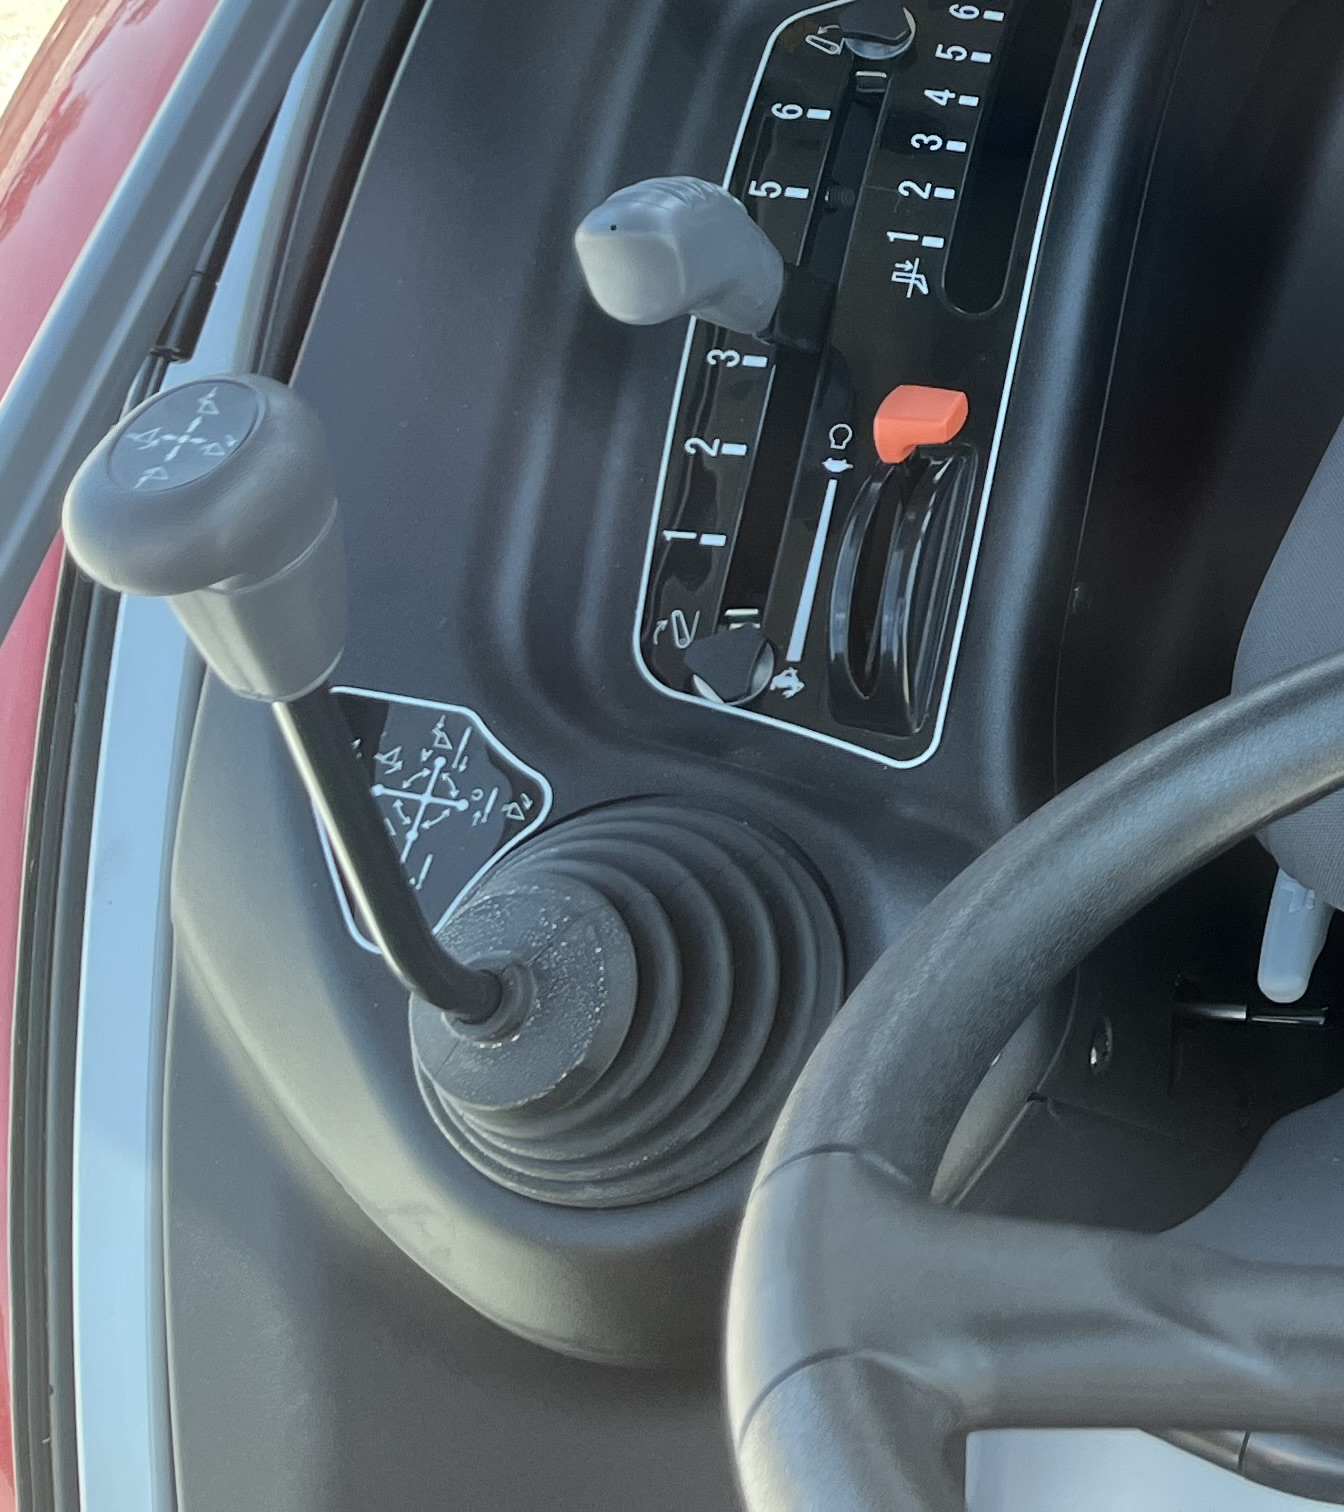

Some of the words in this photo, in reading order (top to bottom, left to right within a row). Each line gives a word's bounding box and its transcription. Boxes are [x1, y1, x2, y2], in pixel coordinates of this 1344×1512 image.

[949, 4, 979, 20] 6
[935, 44, 967, 62] 5
[924, 88, 956, 106] 4
[771, 103, 803, 120] 6
[911, 134, 943, 151] 3
[749, 180, 782, 199] 5
[898, 180, 932, 200] 2
[886, 231, 919, 242] 1
[707, 349, 740, 368] 3
[684, 437, 720, 457] 2
[662, 529, 697, 541] 1
